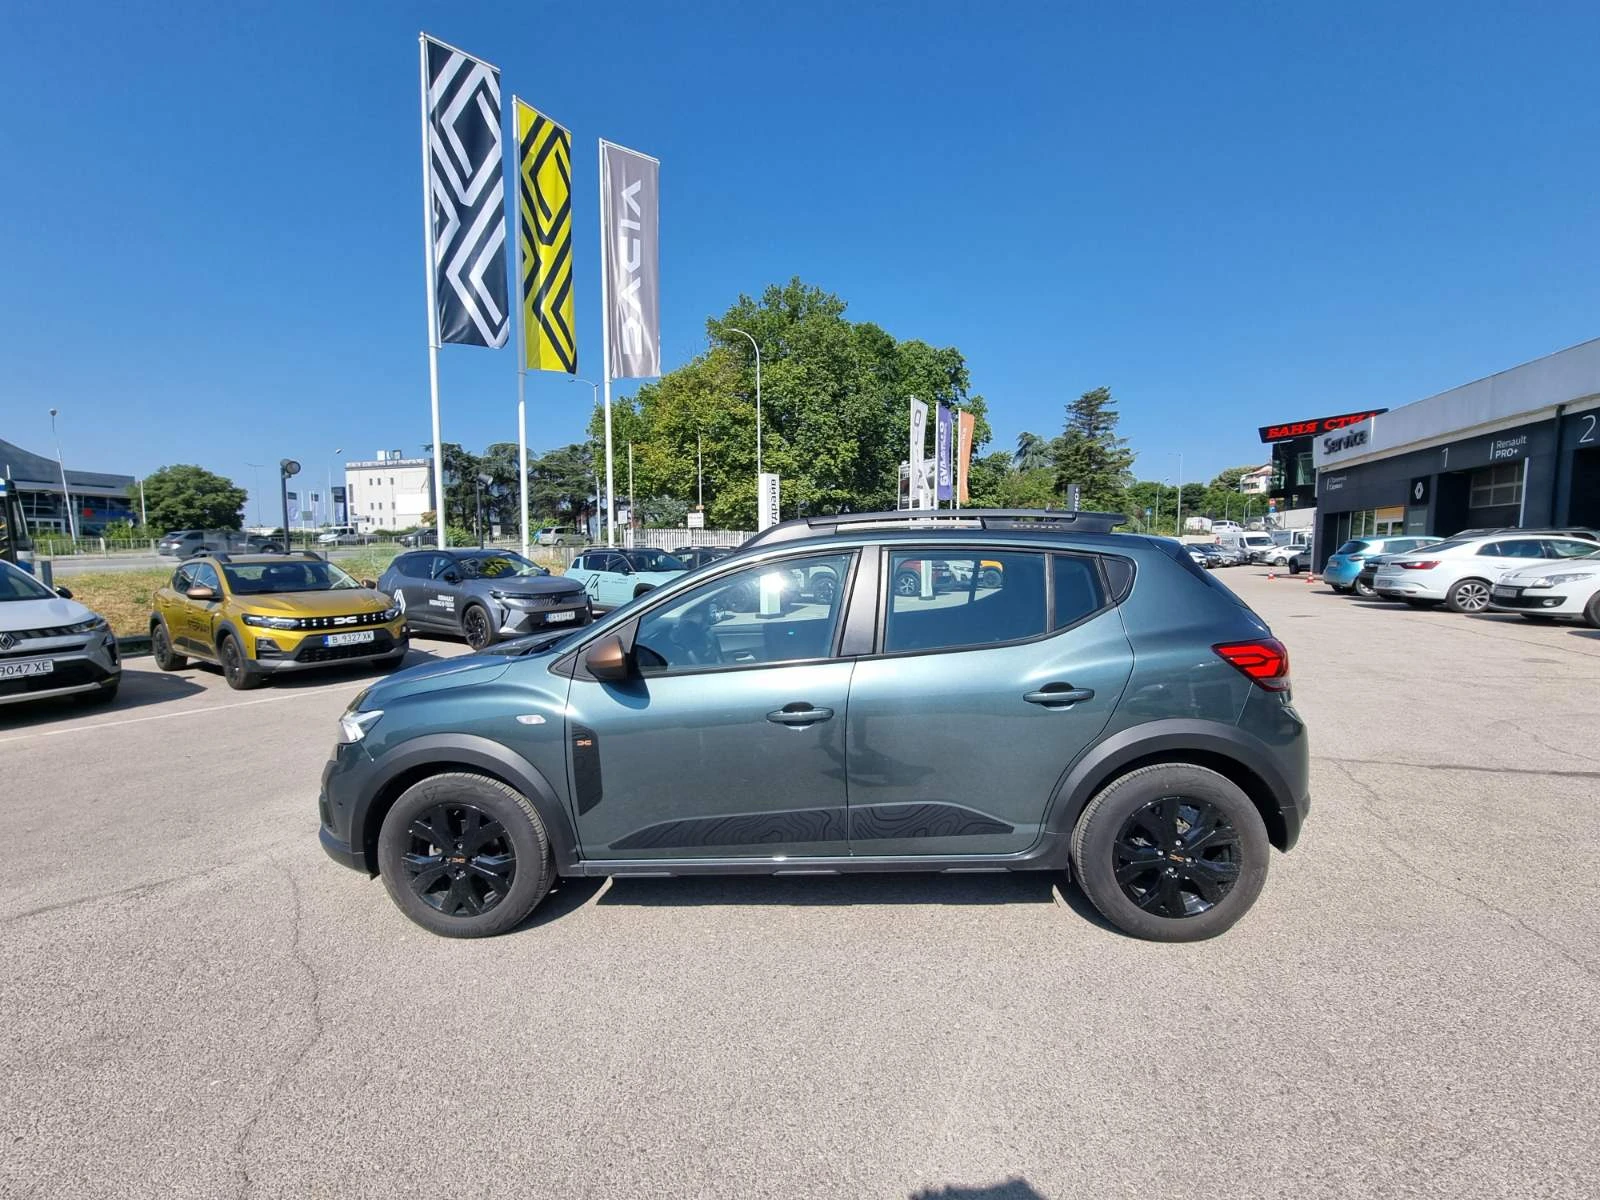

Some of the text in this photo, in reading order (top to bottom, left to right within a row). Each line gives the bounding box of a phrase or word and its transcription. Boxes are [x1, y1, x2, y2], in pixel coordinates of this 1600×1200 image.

[620, 180, 642, 356] DACIA
[1323, 411, 1377, 430] СТИ
[1579, 414, 1597, 443] 2
[1323, 430, 1368, 455] Service
[1496, 435, 1527, 449] Renault
[1441, 447, 1449, 469] 1
[1495, 448, 1518, 459] PRO+
[342, 632, 361, 642] 9327
[34, 661, 51, 672] XE
